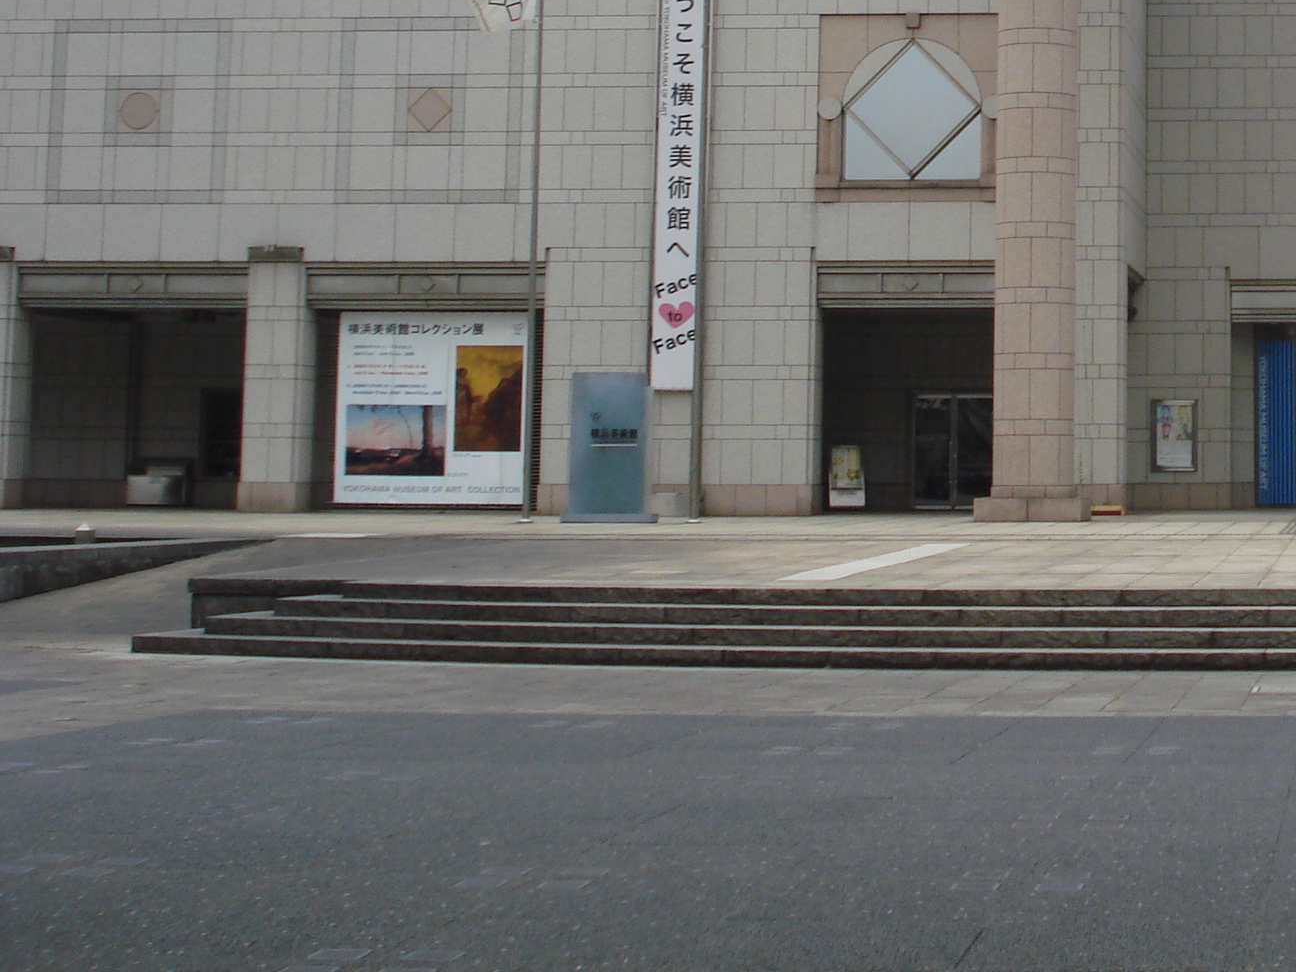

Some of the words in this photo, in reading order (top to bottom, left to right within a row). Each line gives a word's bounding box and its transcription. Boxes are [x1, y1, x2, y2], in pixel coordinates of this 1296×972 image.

[655, 273, 697, 299] Face
[668, 311, 683, 322] to
[652, 329, 696, 354] Face
[467, 485, 521, 494] COLLECTION
